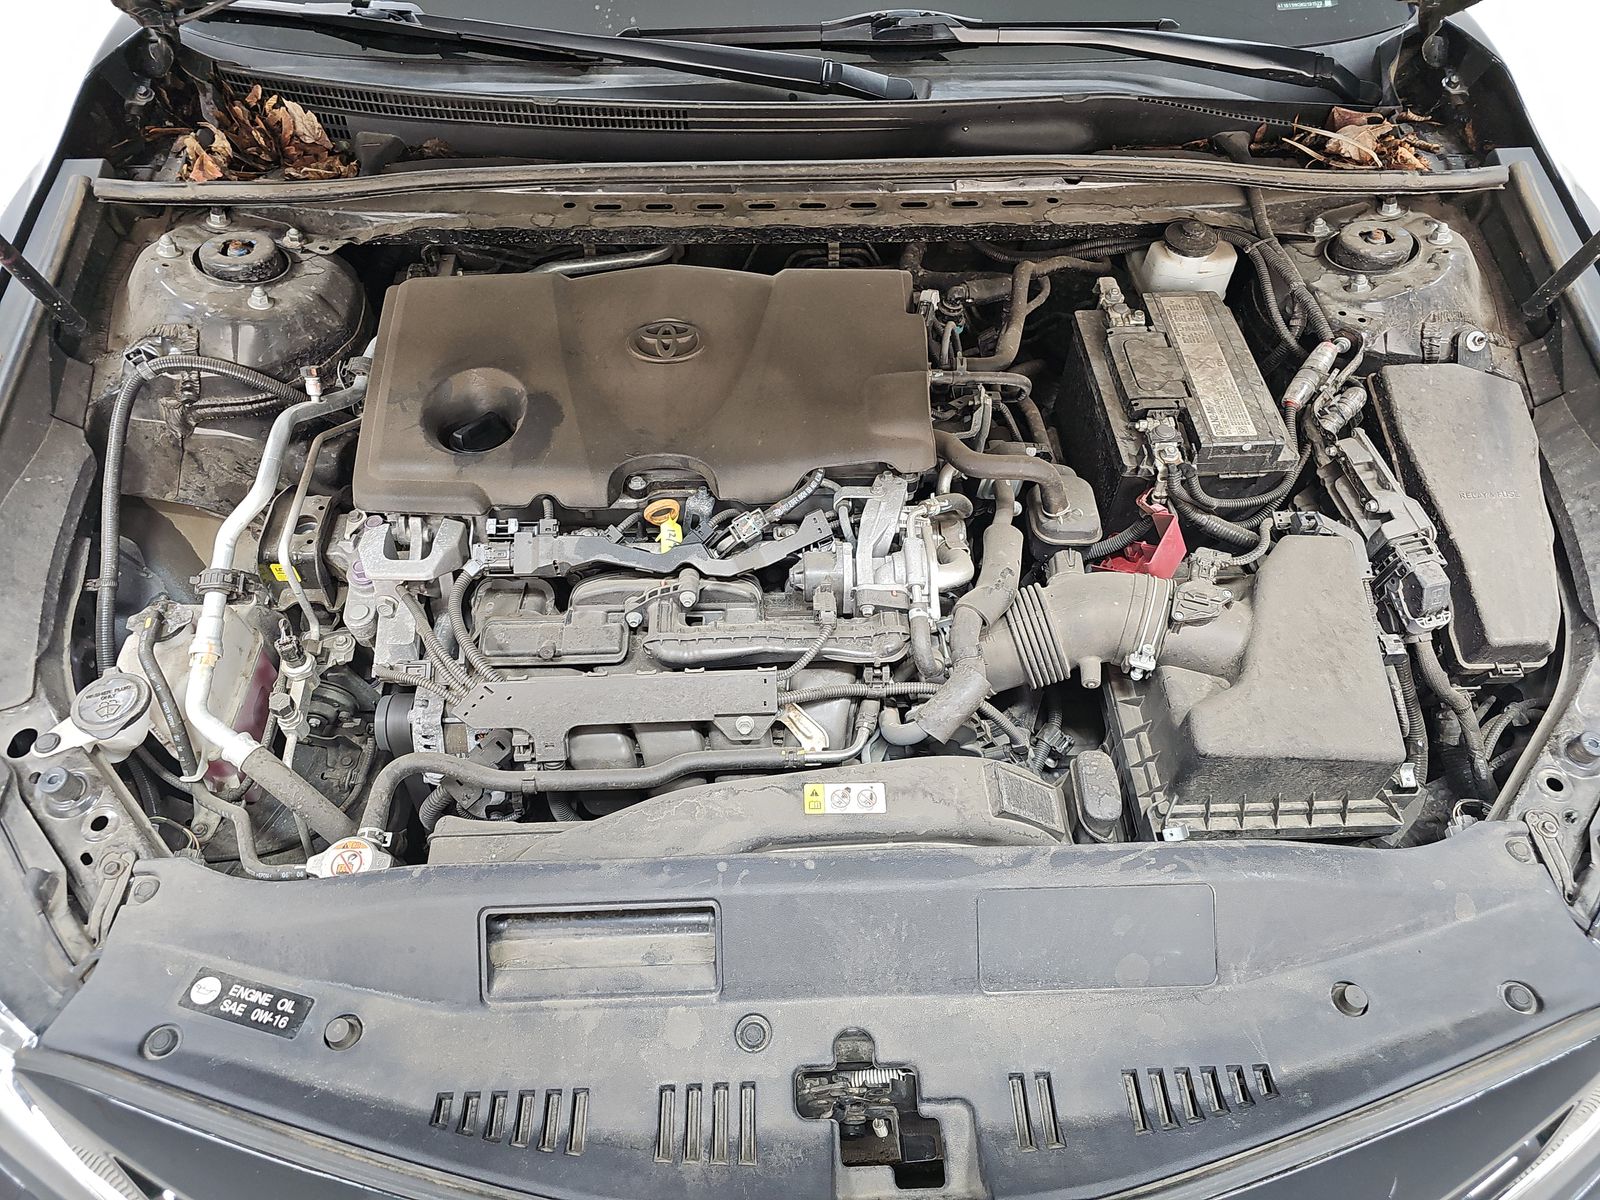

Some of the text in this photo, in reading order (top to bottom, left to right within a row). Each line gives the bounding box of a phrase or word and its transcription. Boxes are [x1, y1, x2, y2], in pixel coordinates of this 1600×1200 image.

[1459, 491, 1488, 499] RELAY
[100, 693, 117, 701] ONLY
[228, 984, 296, 1014] ENGINE OIL
[220, 999, 289, 1029] SAE 0W-16
